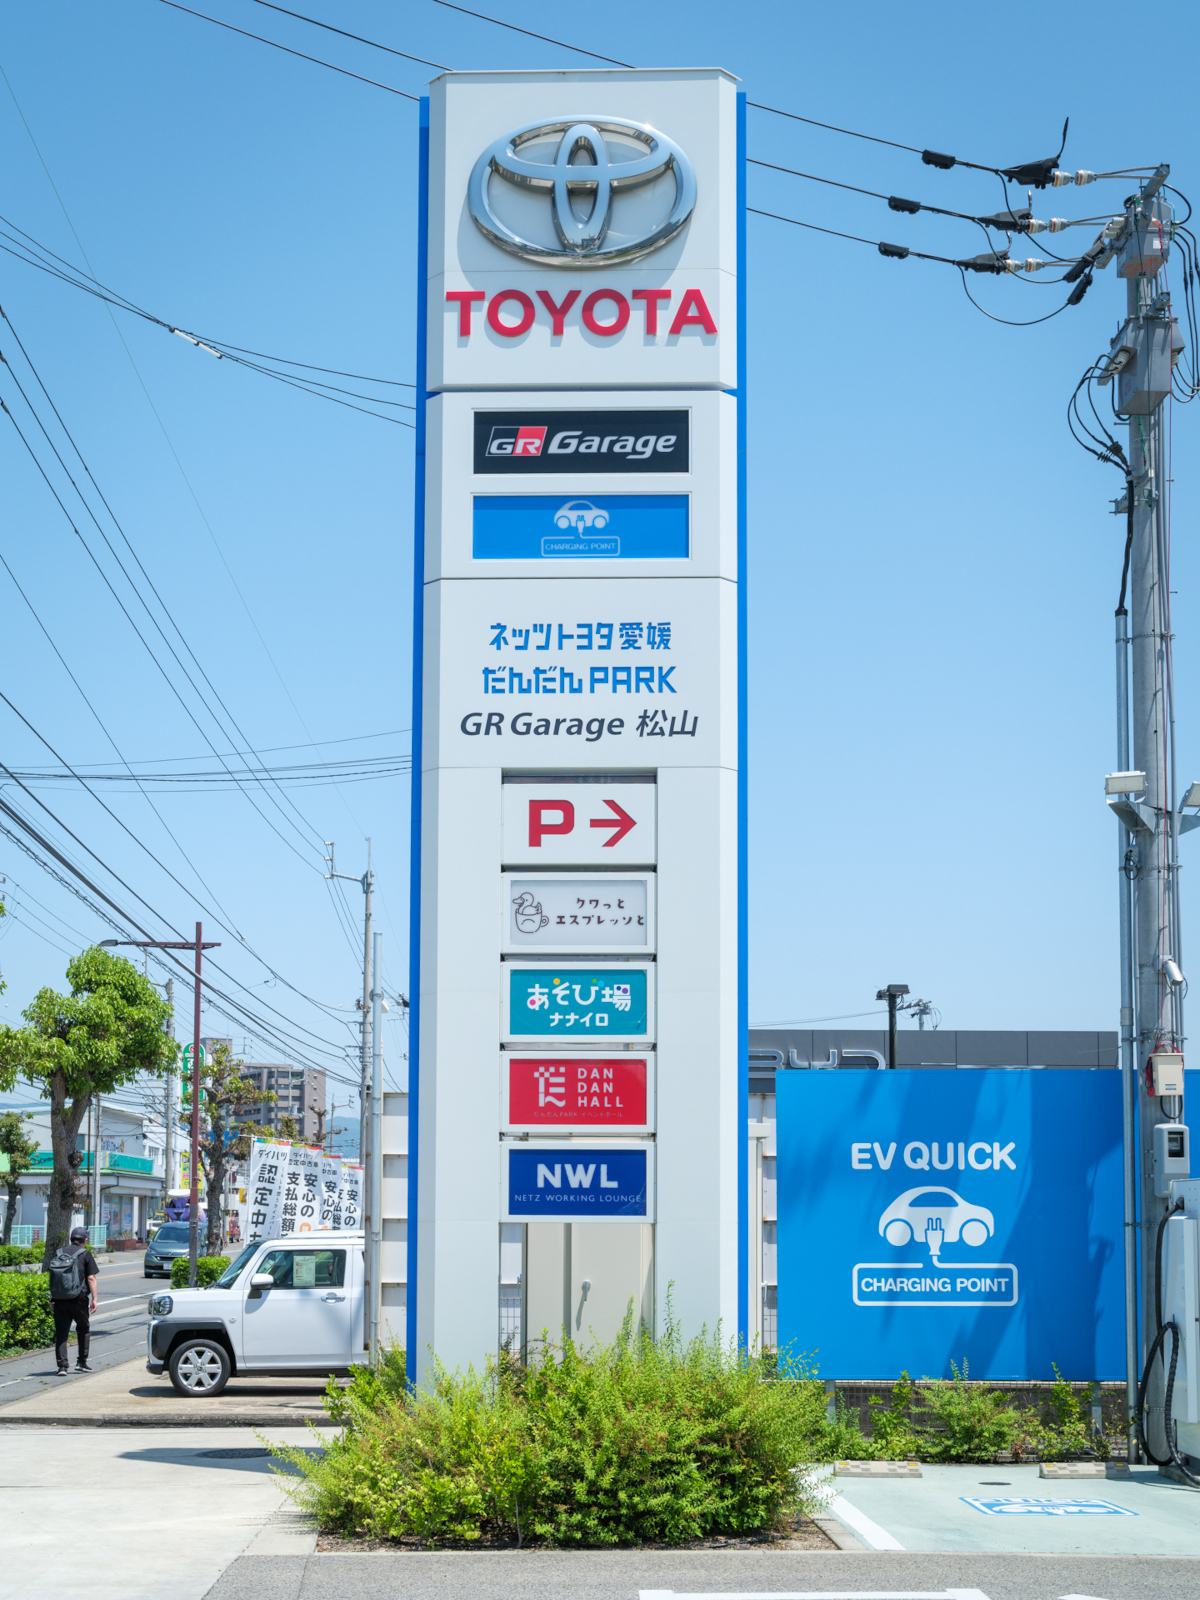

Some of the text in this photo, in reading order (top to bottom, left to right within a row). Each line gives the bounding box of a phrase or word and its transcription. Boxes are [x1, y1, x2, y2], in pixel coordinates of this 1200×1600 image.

[446, 289, 718, 337] TOYOTA
[489, 431, 677, 459] GR Garage
[489, 622, 671, 650] ネッツトヨタ愛媛
[460, 709, 699, 742] GR Garage 松山
[529, 800, 574, 847] P
[576, 898, 625, 909] クワっと
[556, 915, 644, 926] エスプレッソと
[527, 980, 631, 1012] あそび場
[549, 1012, 608, 1027] ナナイロ
[577, 1068, 613, 1079] DAN
[577, 1082, 613, 1093] DAN
[578, 1096, 623, 1107] HALL
[851, 1141, 1016, 1171] EV QUICK
[537, 1164, 618, 1188] NWL
[300, 1173, 318, 1218] 安心の
[321, 1180, 337, 1221] 安心の
[344, 1189, 358, 1226] 安心の
[861, 1278, 1009, 1292] CHARGING POINT
